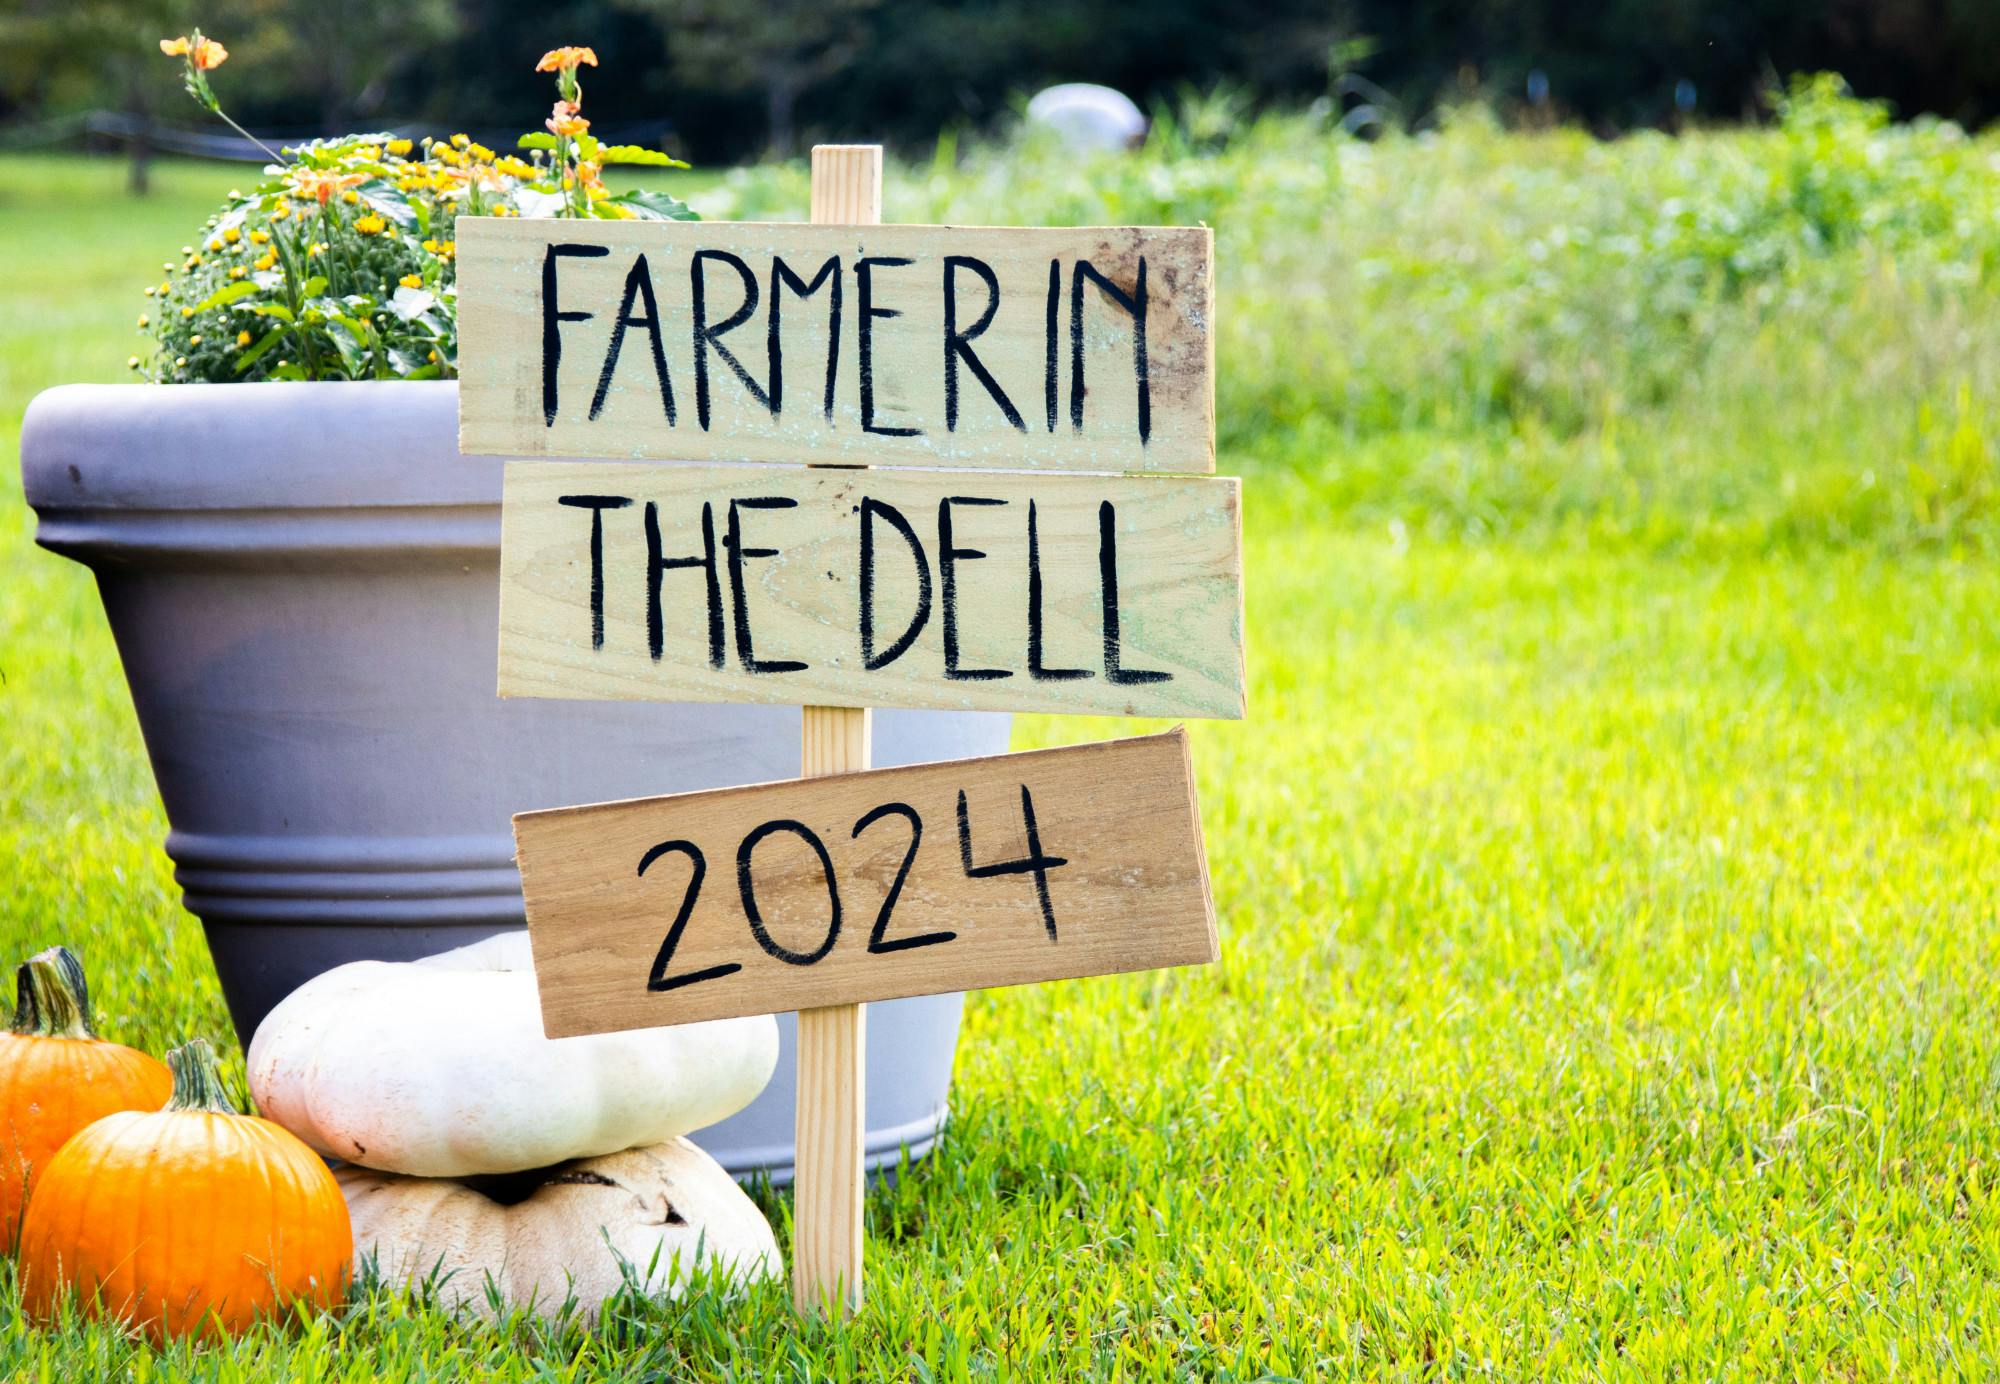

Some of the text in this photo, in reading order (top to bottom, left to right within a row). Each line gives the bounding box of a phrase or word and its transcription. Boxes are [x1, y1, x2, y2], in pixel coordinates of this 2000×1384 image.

[542, 243, 1151, 446] FARMER IN
[558, 495, 1173, 685] THE DELL
[637, 784, 1068, 992] 2024
